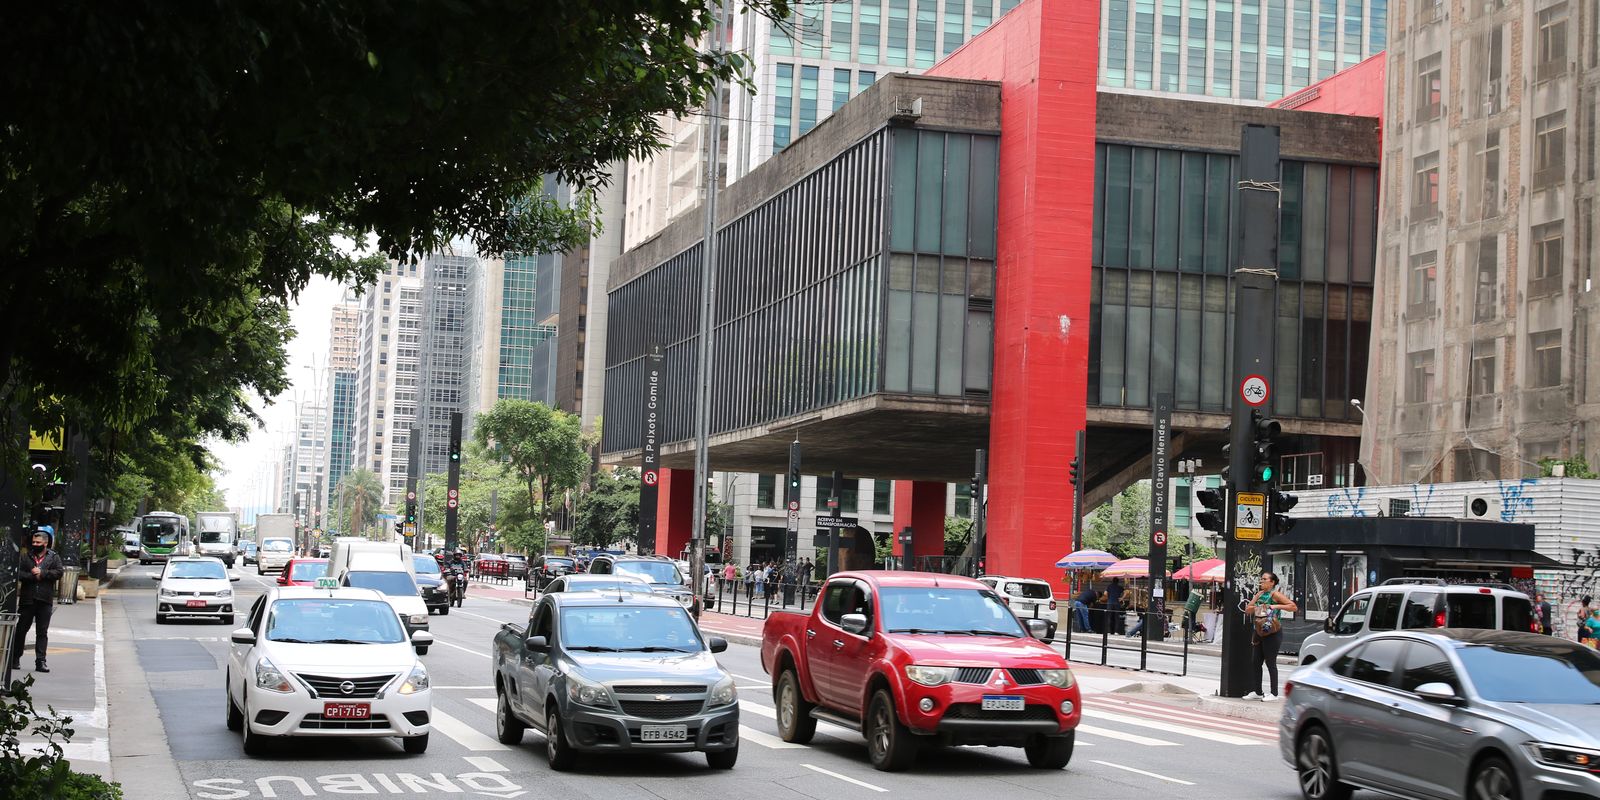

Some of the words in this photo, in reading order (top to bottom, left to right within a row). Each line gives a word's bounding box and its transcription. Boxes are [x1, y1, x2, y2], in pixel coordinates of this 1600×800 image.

[648, 370, 659, 409] Gomide
[646, 412, 657, 452] Peixoto
[1157, 419, 1167, 455] Mendes
[645, 454, 654, 463] R.
[1156, 458, 1166, 489] Otavio
[1155, 491, 1164, 513] Prof.
[1154, 515, 1163, 525] R.
[319, 579, 337, 587] TAXI
[643, 730, 660, 739] FFB
[662, 730, 685, 739] 4542
[193, 772, 528, 800] ÔNIBUS
